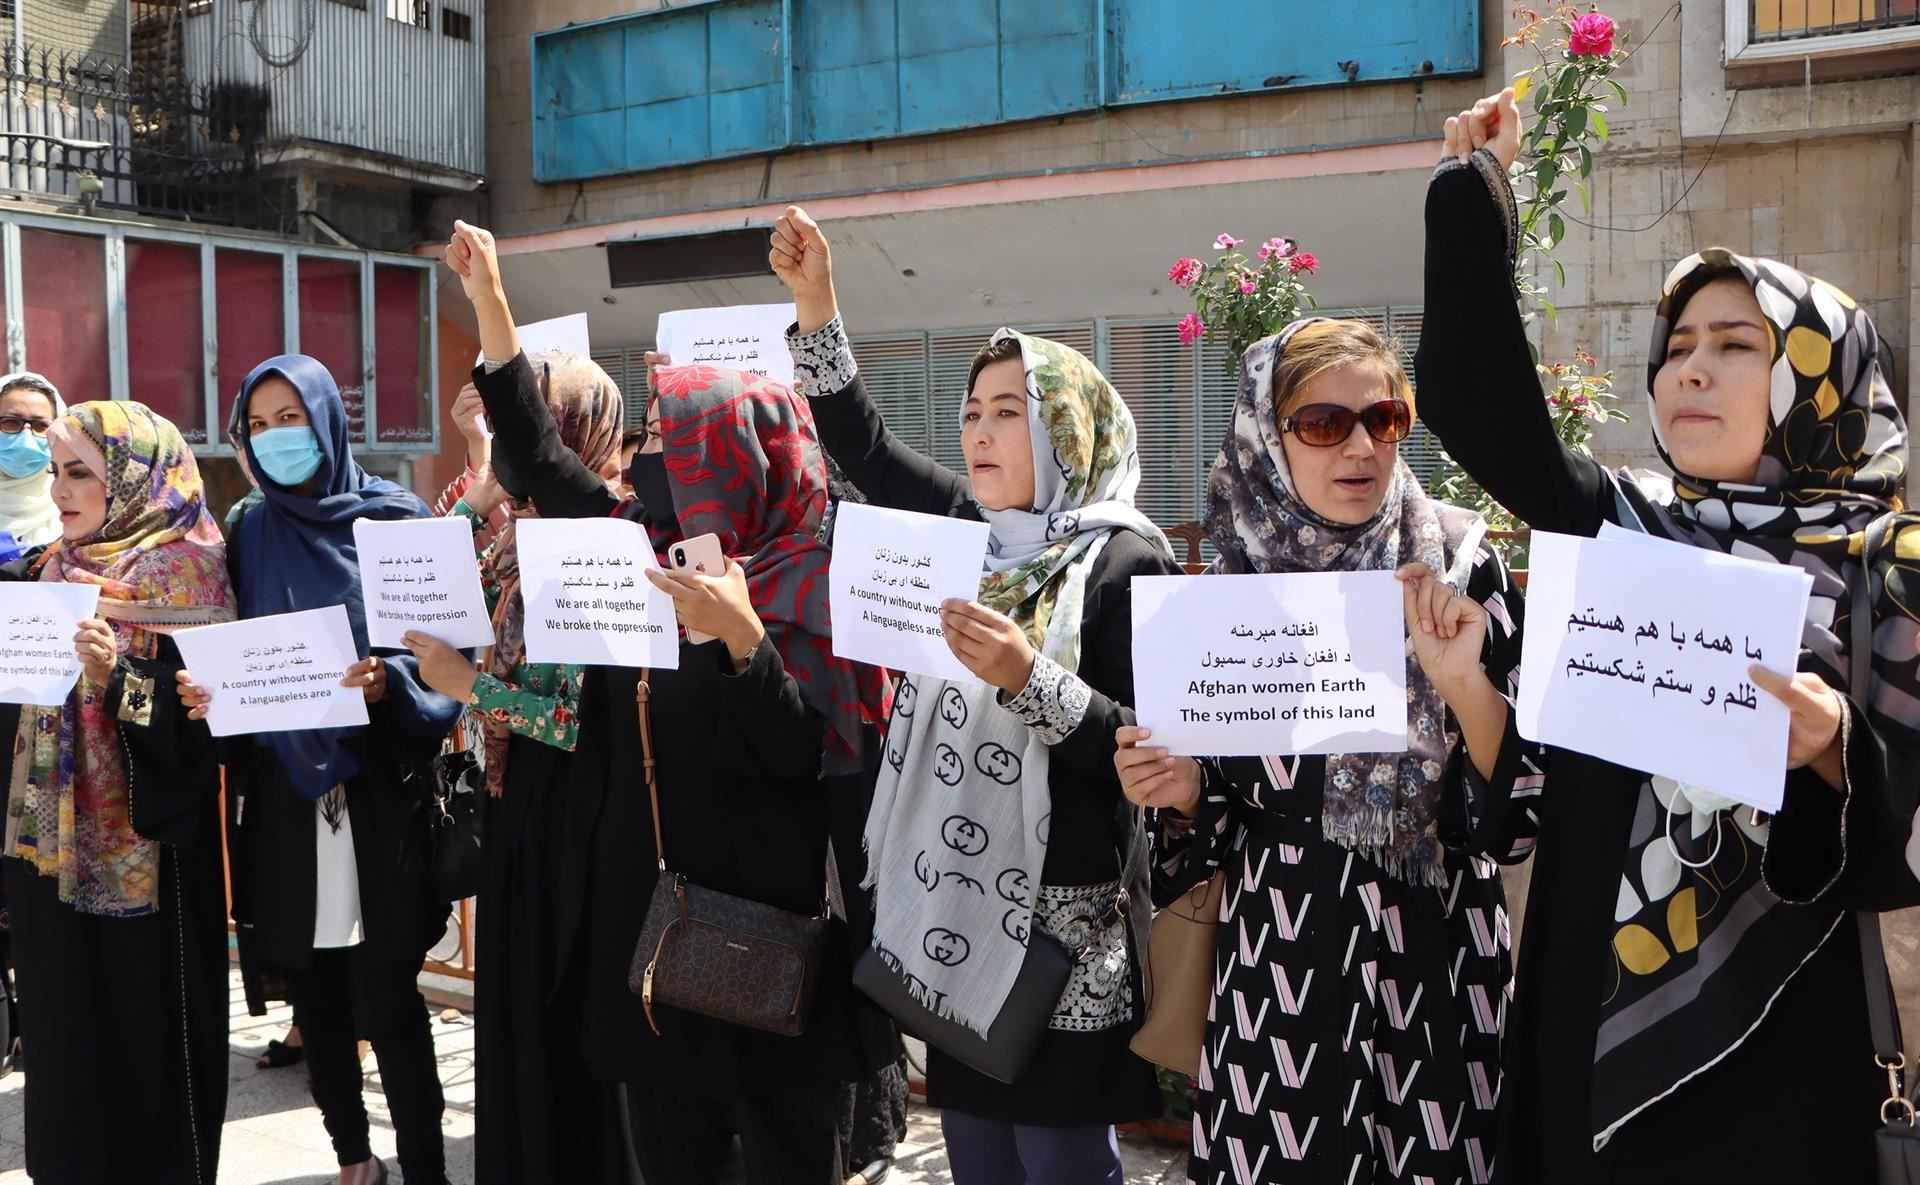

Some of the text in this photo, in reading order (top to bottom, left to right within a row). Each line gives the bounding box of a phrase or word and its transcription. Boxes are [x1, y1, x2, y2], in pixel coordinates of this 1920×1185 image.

[693, 338, 715, 348] هستیم
[718, 338, 726, 348] هم
[728, 337, 734, 347] با
[735, 336, 749, 344] همه
[723, 353, 736, 363] ستم
[746, 351, 759, 363] ظلم
[395, 557, 402, 567] هم
[403, 556, 409, 566] با
[425, 555, 433, 563] ما
[561, 556, 633, 570] ما همه با هم هستیم
[874, 548, 932, 568] کشور بدون زنان
[424, 572, 436, 584] ظلم
[562, 576, 635, 590] ظلم و ستم شکستیم
[872, 569, 930, 589] منطقه ای بی زبان
[380, 592, 448, 604] We are all together
[555, 598, 645, 613] We are all together
[850, 585, 856, 596] A
[857, 589, 887, 606] country
[889, 596, 922, 611] without
[376, 608, 468, 623] We broke the oppression
[863, 610, 869, 621] A
[870, 611, 924, 634] languageless
[545, 619, 663, 634] We broke the oppression
[1281, 621, 1319, 637] افغانه
[1567, 607, 1763, 661] ما همه با هم هستیم
[25, 649, 53, 658] women
[53, 649, 73, 659] Earth
[243, 642, 307, 658] کشور بدون زنان
[1303, 648, 1338, 667] افغان
[1344, 653, 1351, 662] د
[245, 656, 313, 672] منطقه ای بی زبان
[1201, 651, 1246, 668] سمبول
[10, 665, 38, 676] symbol
[40, 666, 48, 675] of
[49, 667, 60, 676] this
[63, 667, 76, 677] lan
[222, 671, 345, 690] A country without women
[1188, 678, 1366, 697] Afghan women Earth
[1566, 652, 1758, 714] ظلم و ستم شکستیم
[240, 689, 332, 705] A languageless area
[1180, 704, 1375, 724] The symbol of this land
